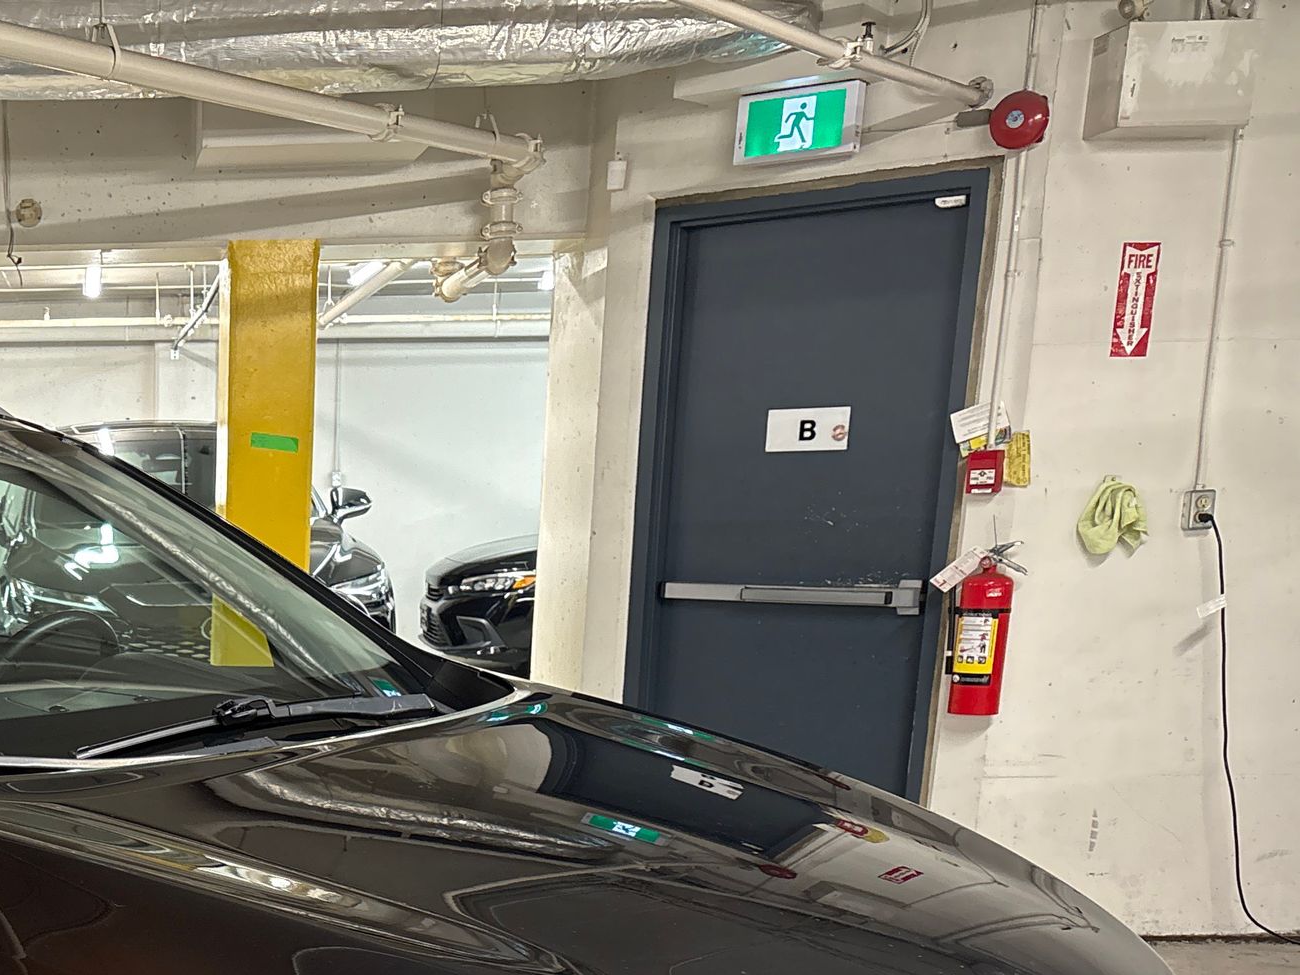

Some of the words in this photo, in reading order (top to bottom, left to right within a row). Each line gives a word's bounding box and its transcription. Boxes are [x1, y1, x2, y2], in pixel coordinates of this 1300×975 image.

[1127, 254, 1153, 268] FIRE
[1126, 272, 1142, 346] EXTINGUISHER
[798, 419, 817, 441] B
